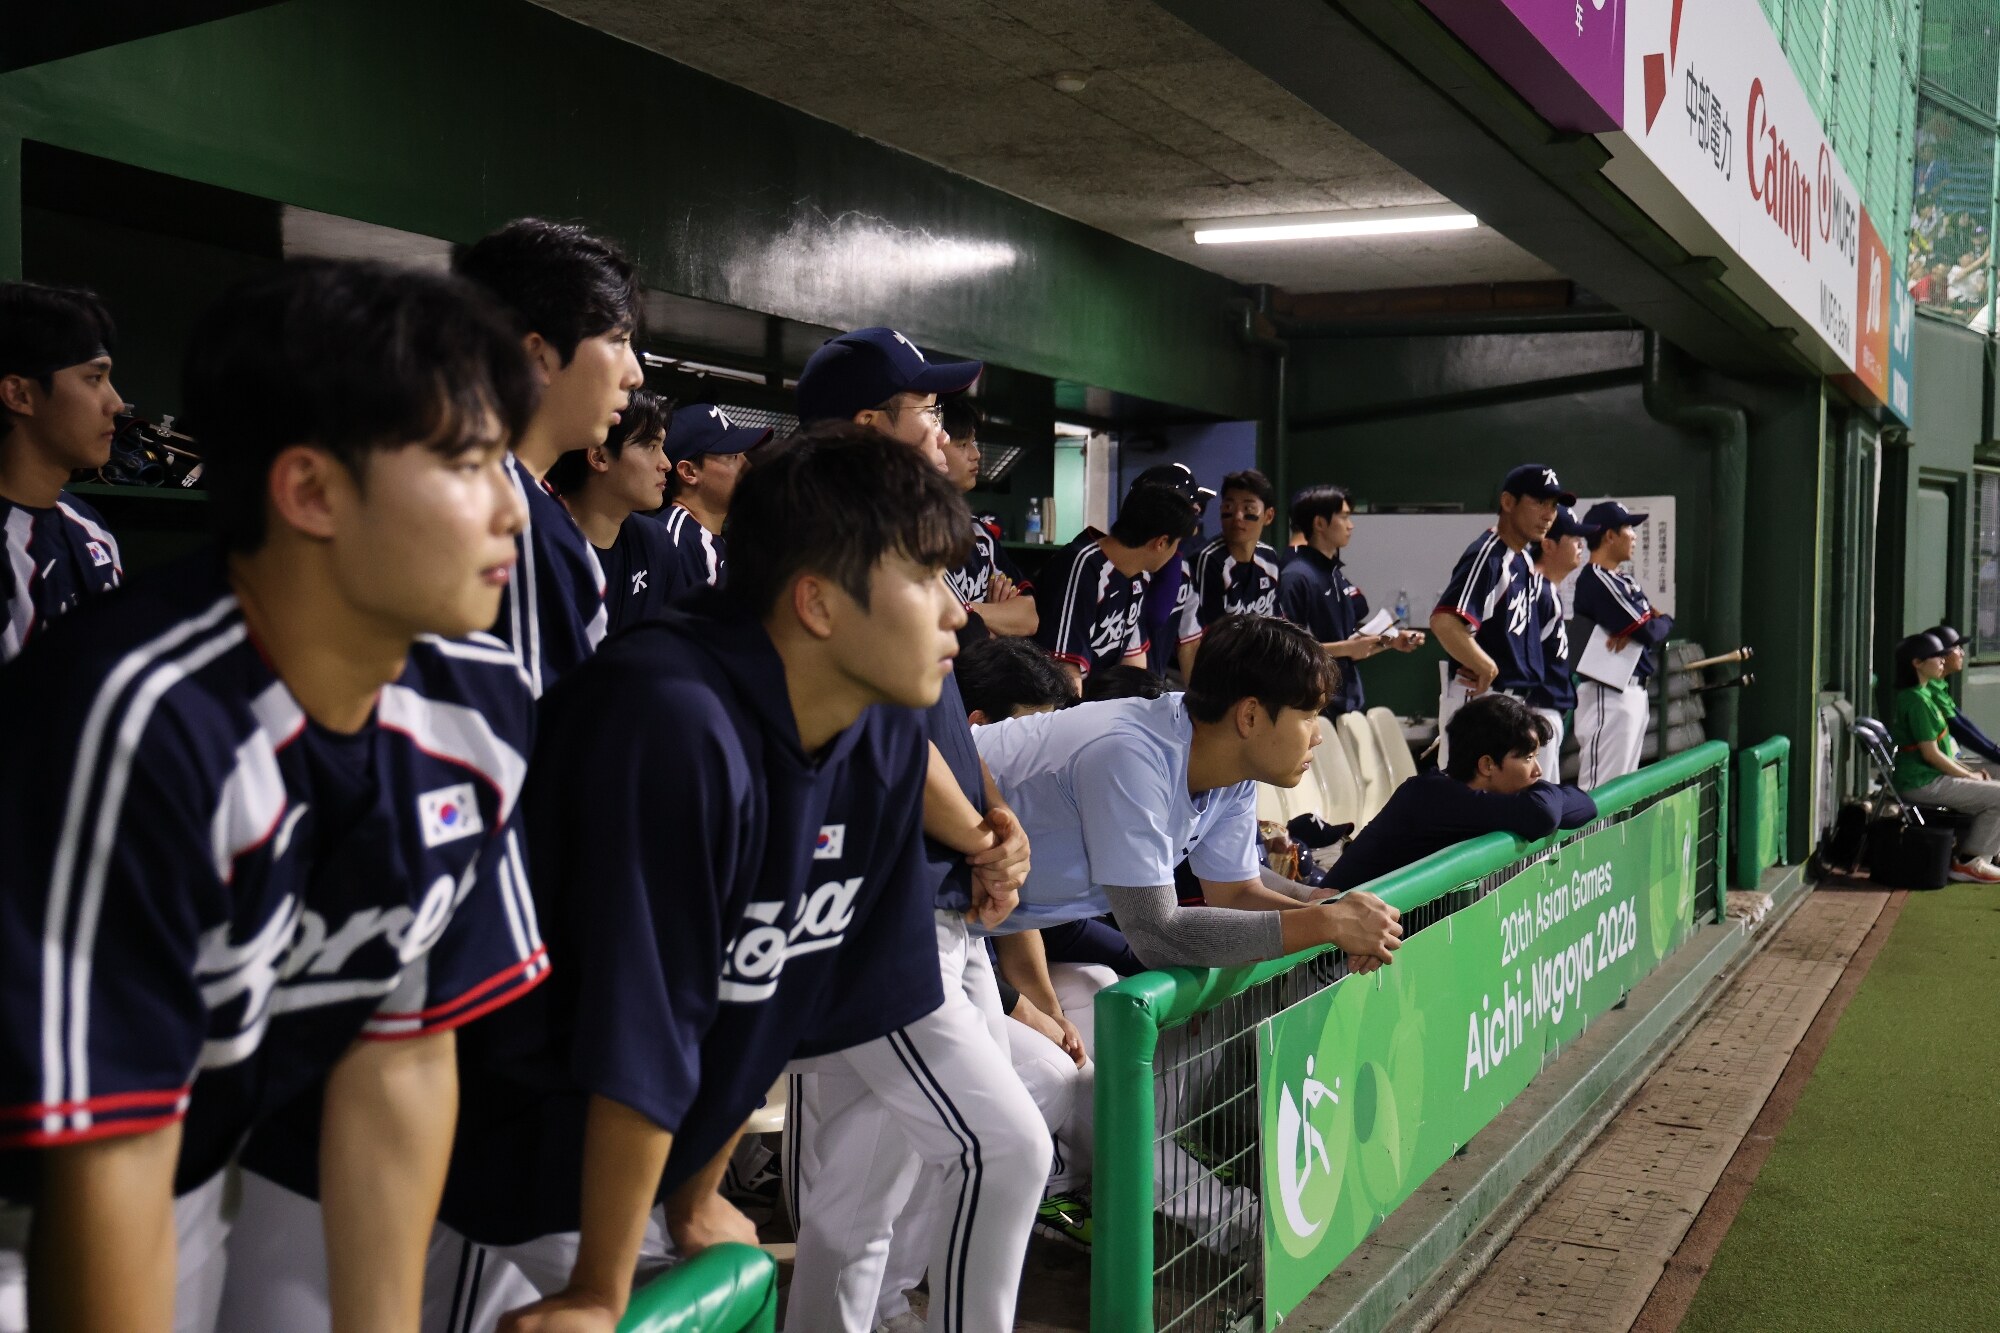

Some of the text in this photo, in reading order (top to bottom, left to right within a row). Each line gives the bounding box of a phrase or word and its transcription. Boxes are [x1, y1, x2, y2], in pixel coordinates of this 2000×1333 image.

[1686, 61, 1732, 181] 中部電力
[1747, 77, 1811, 262] Canon
[1832, 178, 1856, 268] MUFG
[632, 570, 648, 596] K
[1500, 860, 1612, 967] 20th Asian Games
[1463, 895, 1637, 1092] Aichi-Nagoya 2026
